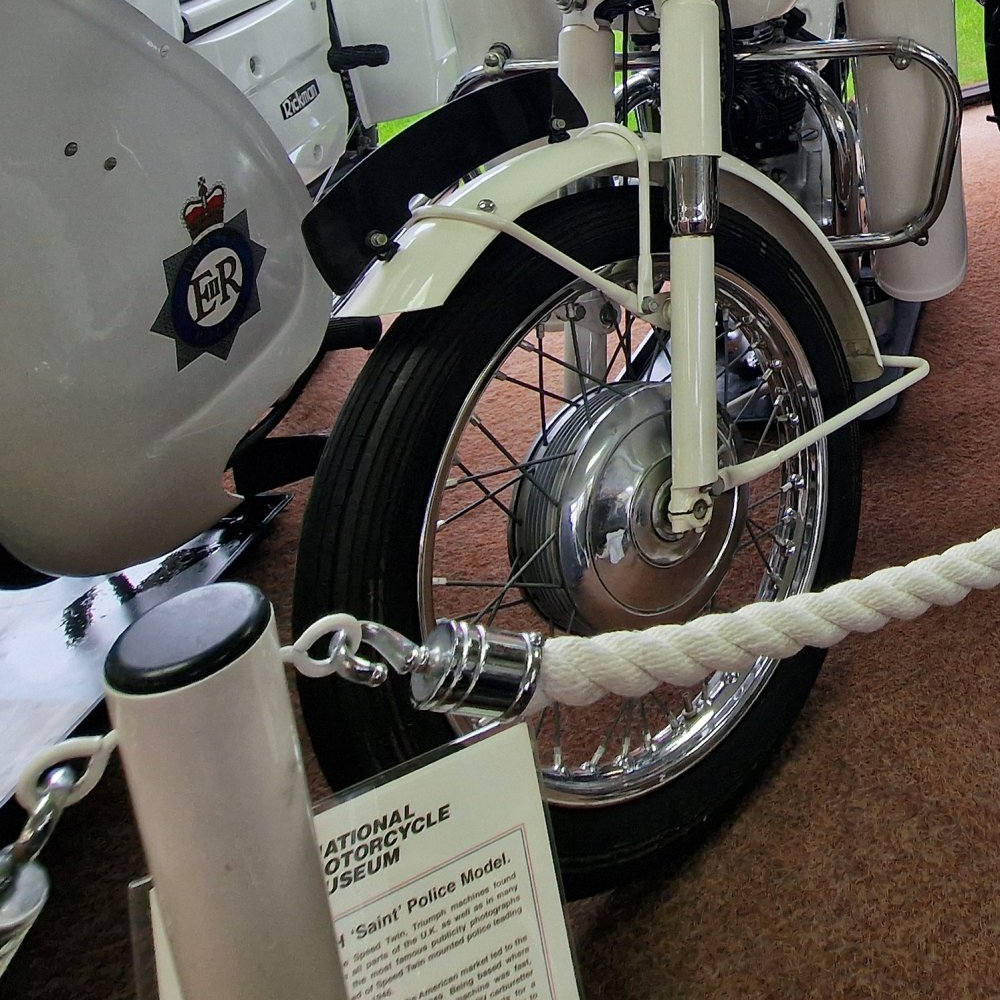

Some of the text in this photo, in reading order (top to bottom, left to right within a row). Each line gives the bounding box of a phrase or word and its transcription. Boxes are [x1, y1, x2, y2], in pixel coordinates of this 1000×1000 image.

[281, 83, 318, 119] Rickman
[320, 804, 415, 858] ATIONAL
[325, 804, 450, 875] OTORCYCLE
[327, 846, 400, 895] USEUM
[407, 881, 456, 914] Police
[461, 852, 511, 887] Model.
[412, 908, 447, 931] Triumph
[451, 887, 490, 912] machines
[493, 871, 517, 888] found
[431, 923, 467, 948] publicity
[470, 895, 521, 928] photographs
[454, 908, 471, 922] well
[486, 896, 494, 905] in
[496, 884, 518, 900] many
[466, 923, 491, 943] police
[418, 973, 459, 999] American
[460, 956, 489, 976] market
